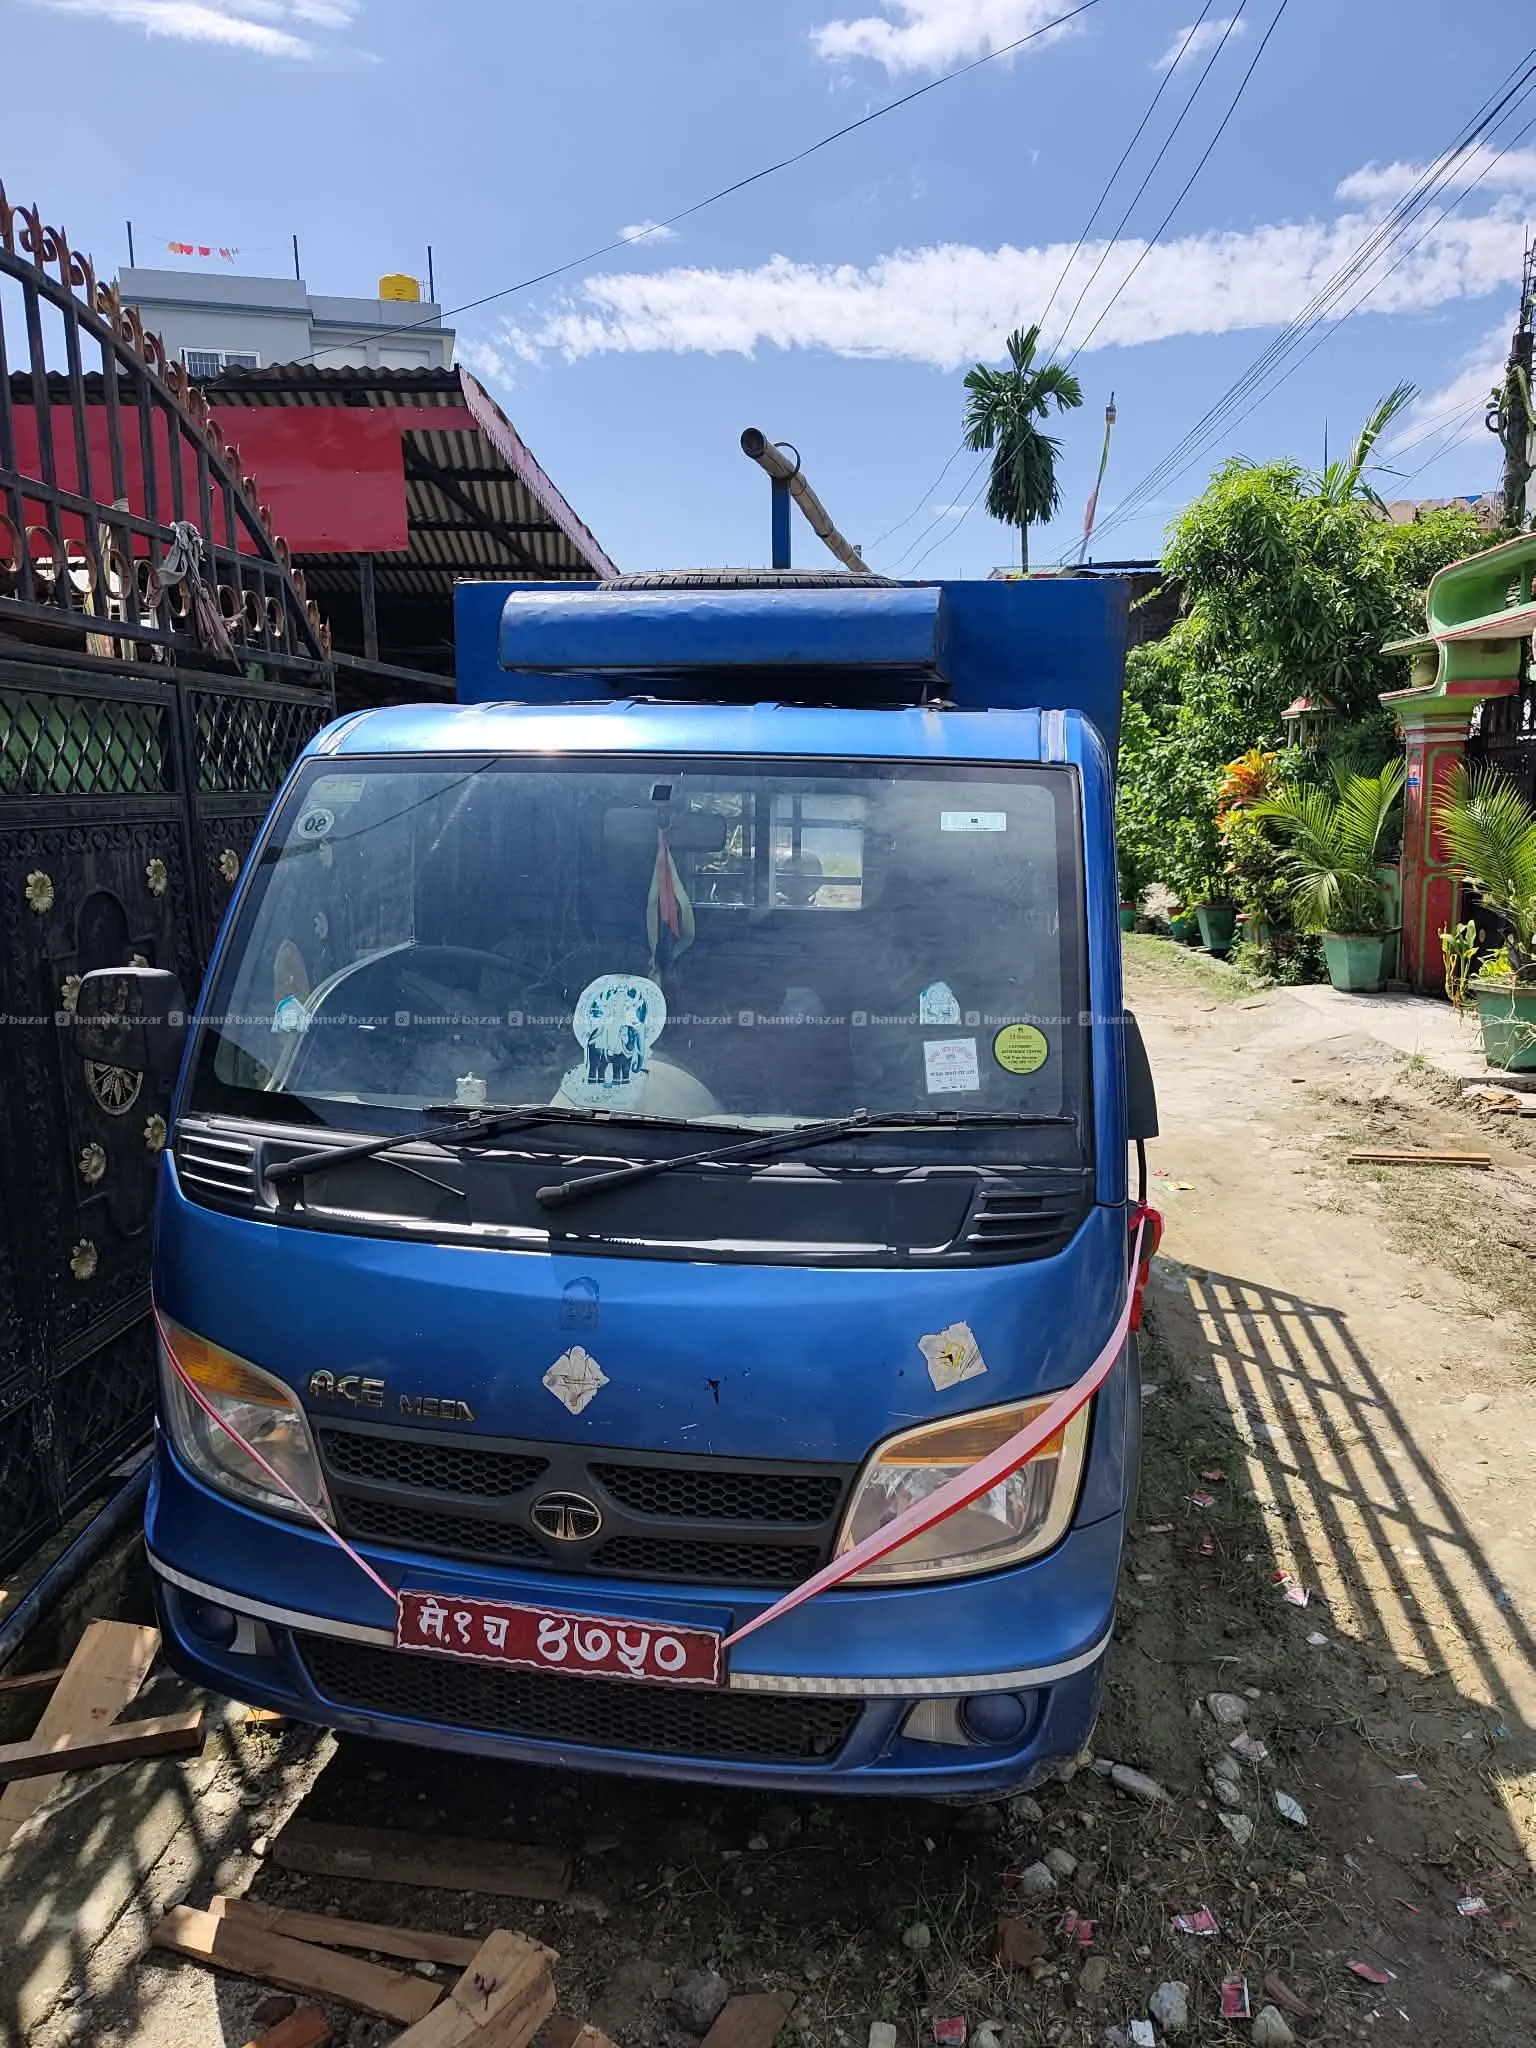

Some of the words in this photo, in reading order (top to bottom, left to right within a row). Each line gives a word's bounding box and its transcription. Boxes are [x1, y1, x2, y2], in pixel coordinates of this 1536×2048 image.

[309, 1368, 385, 1409] ACE
[483, 1615, 510, 1649] च
[536, 1614, 687, 1676] ४७५०
